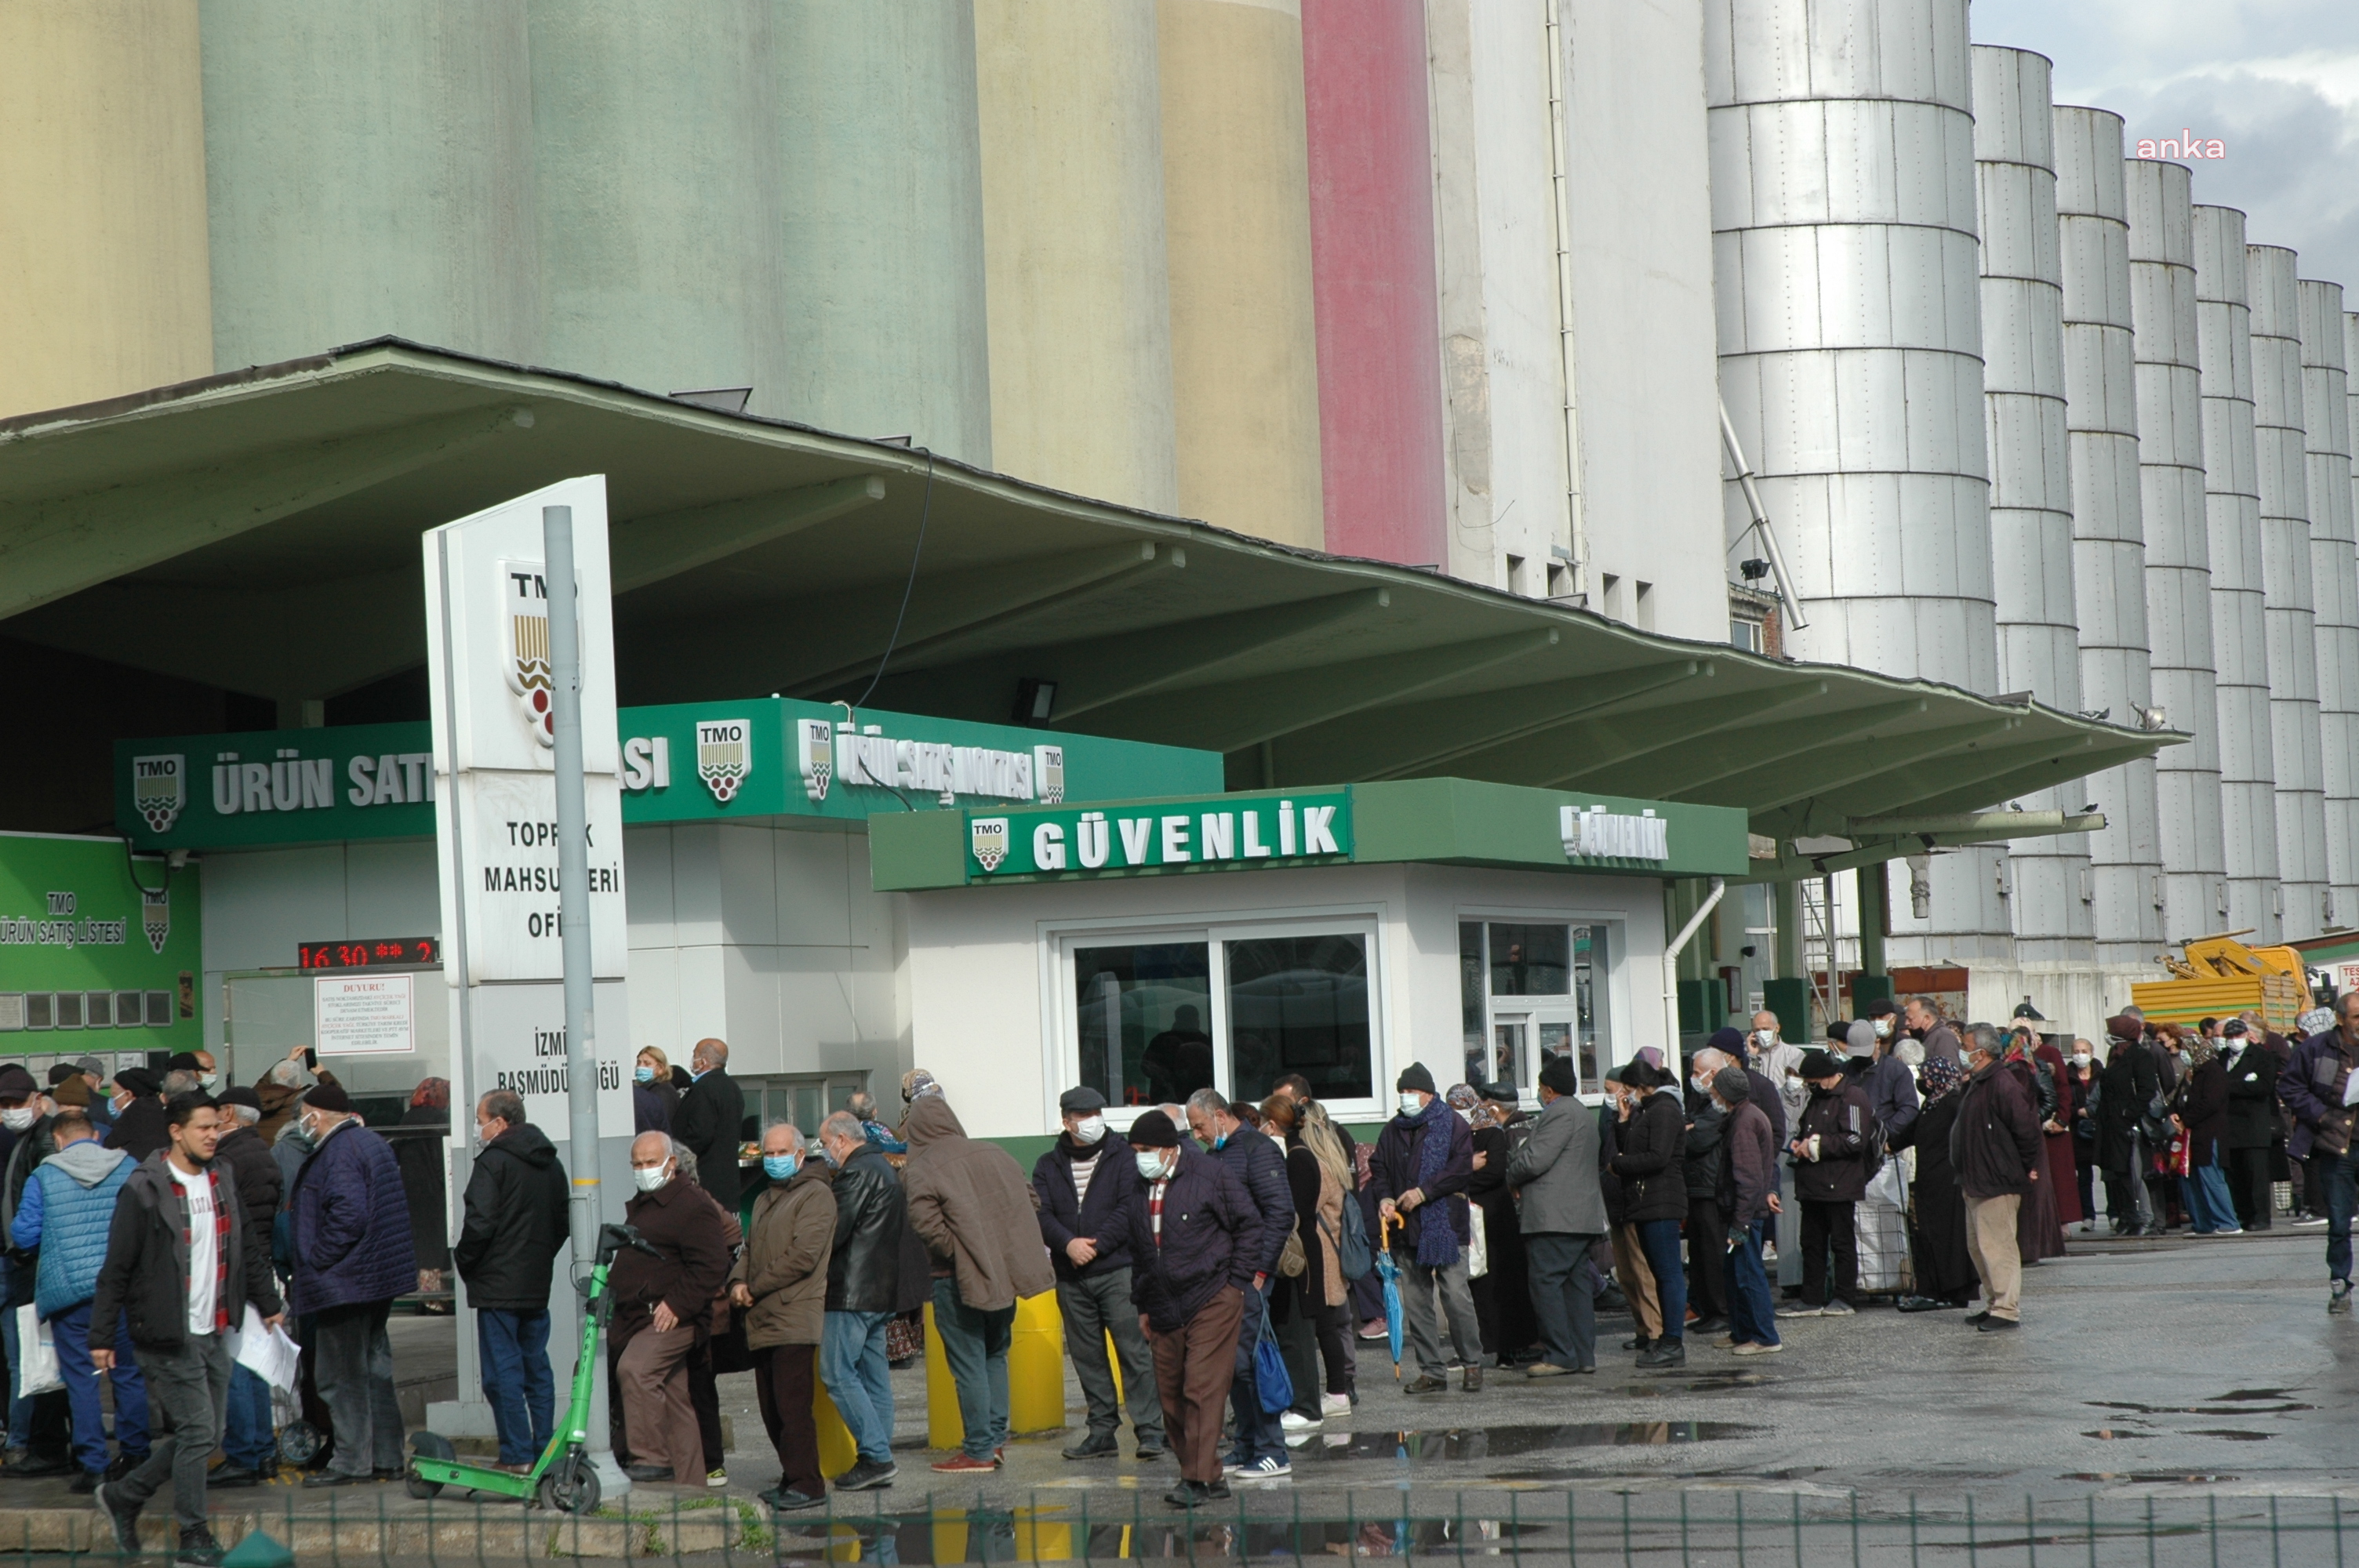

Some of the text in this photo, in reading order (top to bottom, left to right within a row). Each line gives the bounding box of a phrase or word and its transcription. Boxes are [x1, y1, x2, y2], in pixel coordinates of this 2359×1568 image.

[700, 726, 742, 743] TMO
[810, 724, 829, 741] TMO
[136, 760, 176, 777] TMO
[1045, 751, 1061, 766] TMO
[213, 749, 335, 815] ÜRÜN
[348, 753, 435, 807] SATI
[507, 822, 594, 848] TOPRK
[974, 824, 1002, 836] TMO
[1033, 800, 1339, 871] GÜVENLİK
[485, 862, 618, 893] MAHSUERİ
[47, 893, 75, 914] TMO
[0, 916, 125, 948] ÜRÜN SATIŞ LİSTESİ
[529, 906, 562, 938] OFİ
[343, 983, 384, 992] DUYURU!
[535, 1026, 568, 1056] İZMİ
[498, 1061, 620, 1102] BAŞMÜDÜĞÜ
